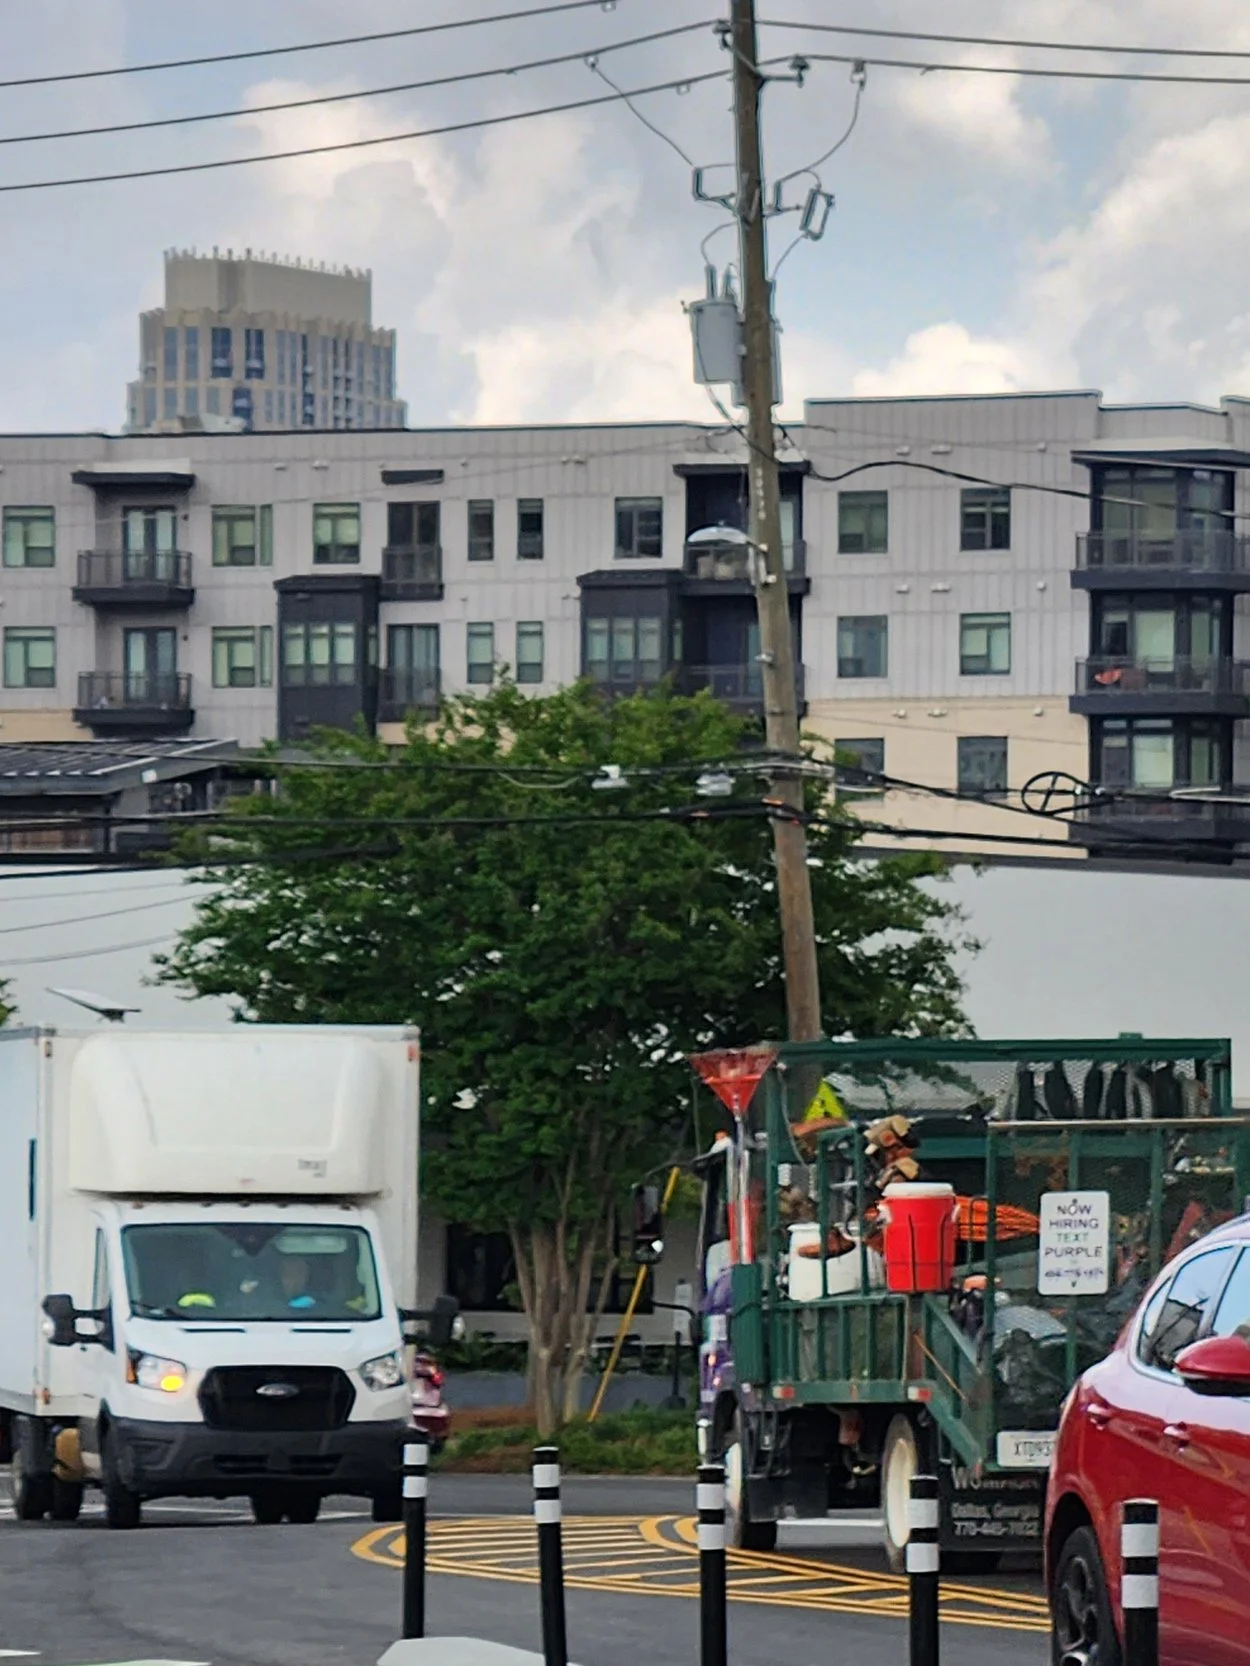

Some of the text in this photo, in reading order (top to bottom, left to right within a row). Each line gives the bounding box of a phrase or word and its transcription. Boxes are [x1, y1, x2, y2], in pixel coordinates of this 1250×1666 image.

[1057, 1204, 1093, 1216] NOW
[1049, 1218, 1099, 1230] HIRING
[1057, 1232, 1089, 1242] TEXT
[1044, 1246, 1103, 1258] PURPLE
